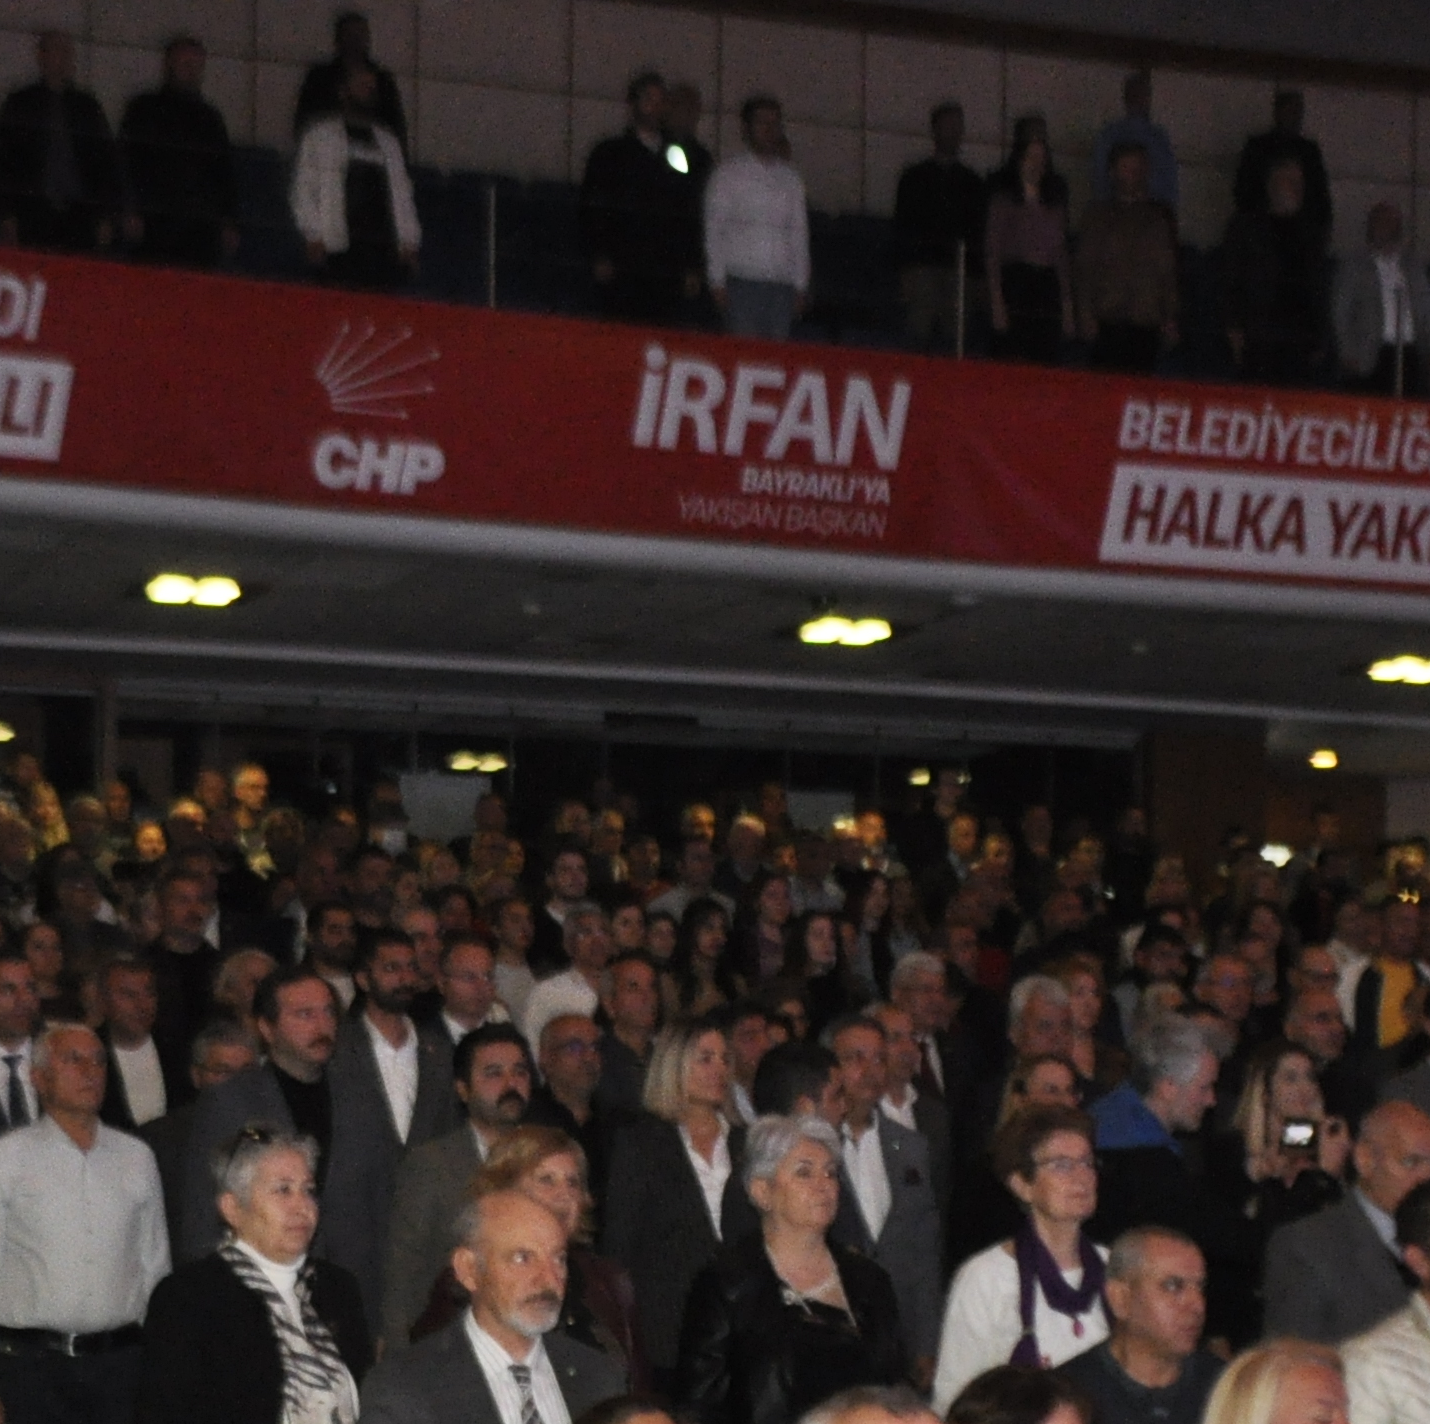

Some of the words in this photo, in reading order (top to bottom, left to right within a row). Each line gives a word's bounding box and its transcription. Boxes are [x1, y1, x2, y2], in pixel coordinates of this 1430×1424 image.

[632, 344, 912, 471] İRFAN
[311, 434, 446, 496] CHP
[1123, 483, 1307, 554] HALKA
